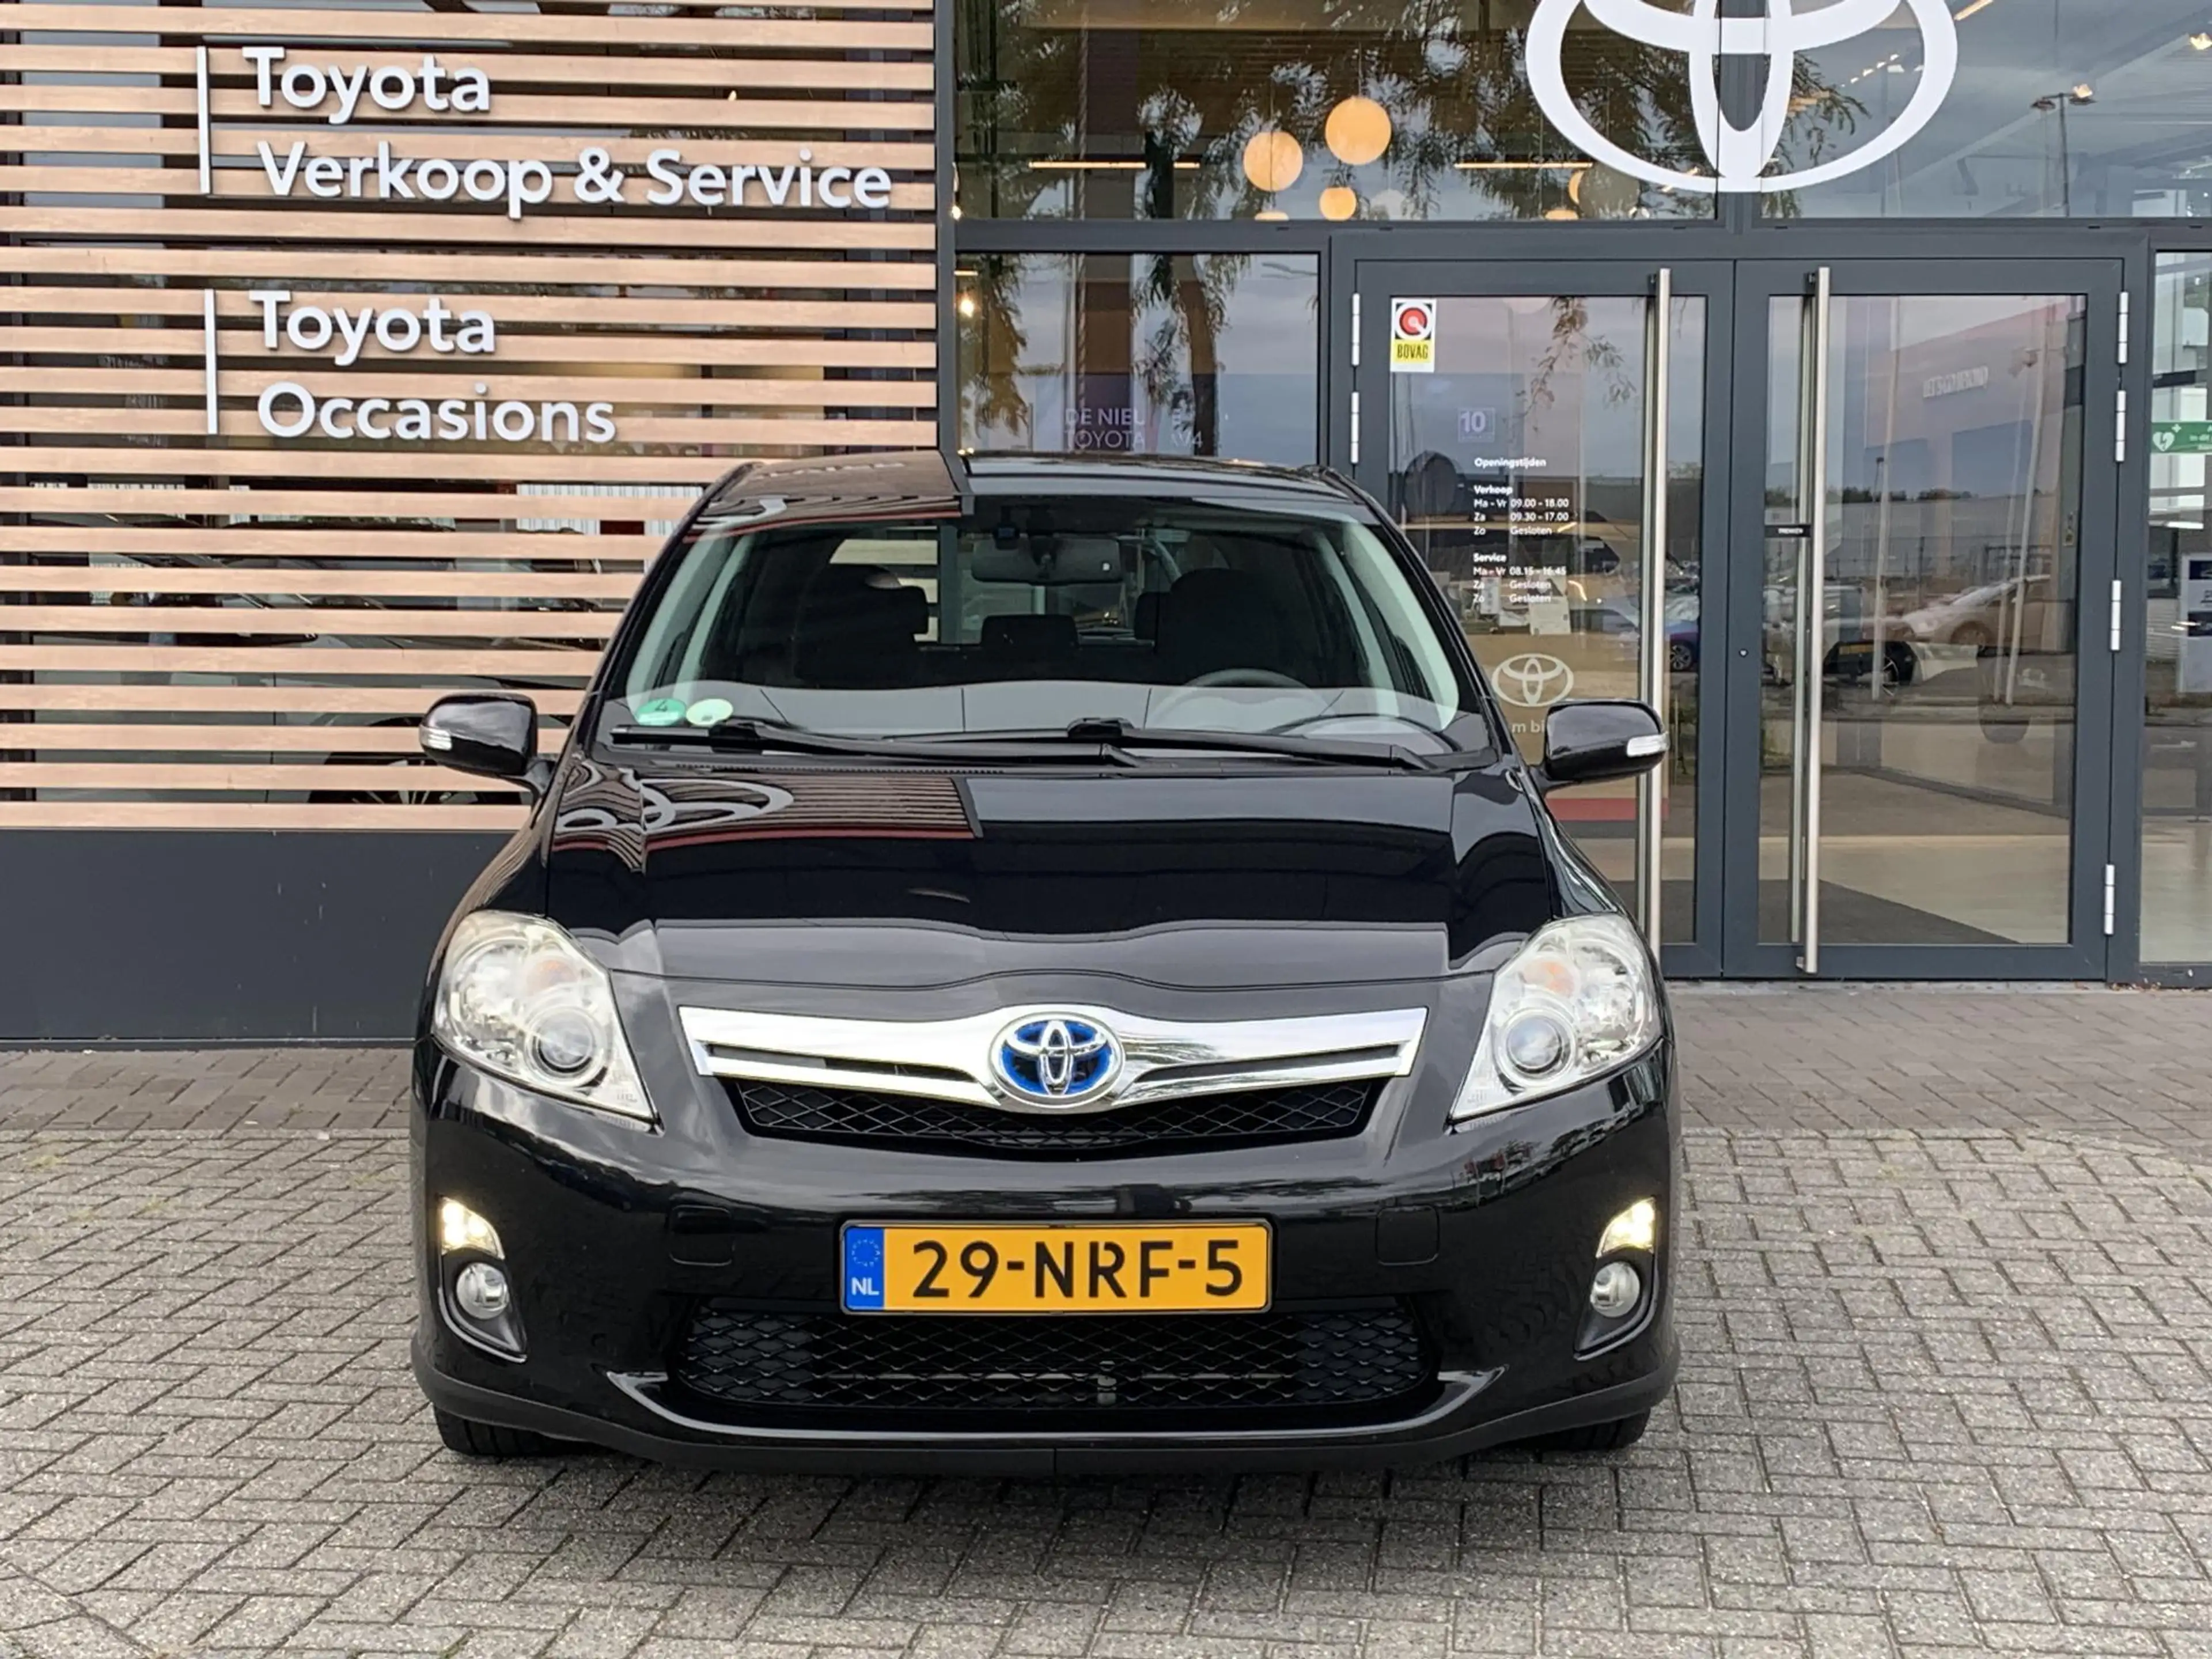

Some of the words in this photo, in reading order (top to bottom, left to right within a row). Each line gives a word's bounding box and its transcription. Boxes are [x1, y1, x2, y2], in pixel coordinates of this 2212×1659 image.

[242, 46, 491, 125] Toyota
[256, 139, 554, 219] Verkoop
[574, 146, 625, 205] &
[646, 147, 892, 209] Service
[248, 289, 496, 366] Toyota
[1396, 343, 1429, 359] BOVAG
[257, 381, 616, 444] Occasions
[1474, 457, 1547, 469] Openingstijden
[1474, 485, 1513, 495] Verkoop
[1474, 498, 1488, 508] Ma
[1496, 498, 1507, 508] Vr
[1510, 498, 1536, 508] 09.00
[1474, 512, 1486, 521] Za
[1544, 512, 1570, 521] 17.00
[1474, 525, 1486, 536] Zo
[1510, 525, 1553, 536] Gesloten
[1473, 552, 1508, 562] Service
[1509, 579, 1552, 590] Gesloten
[1509, 593, 1552, 603] Gesloten
[912, 1239, 1243, 1299] 29-NRF-5
[850, 1277, 880, 1296] NL
